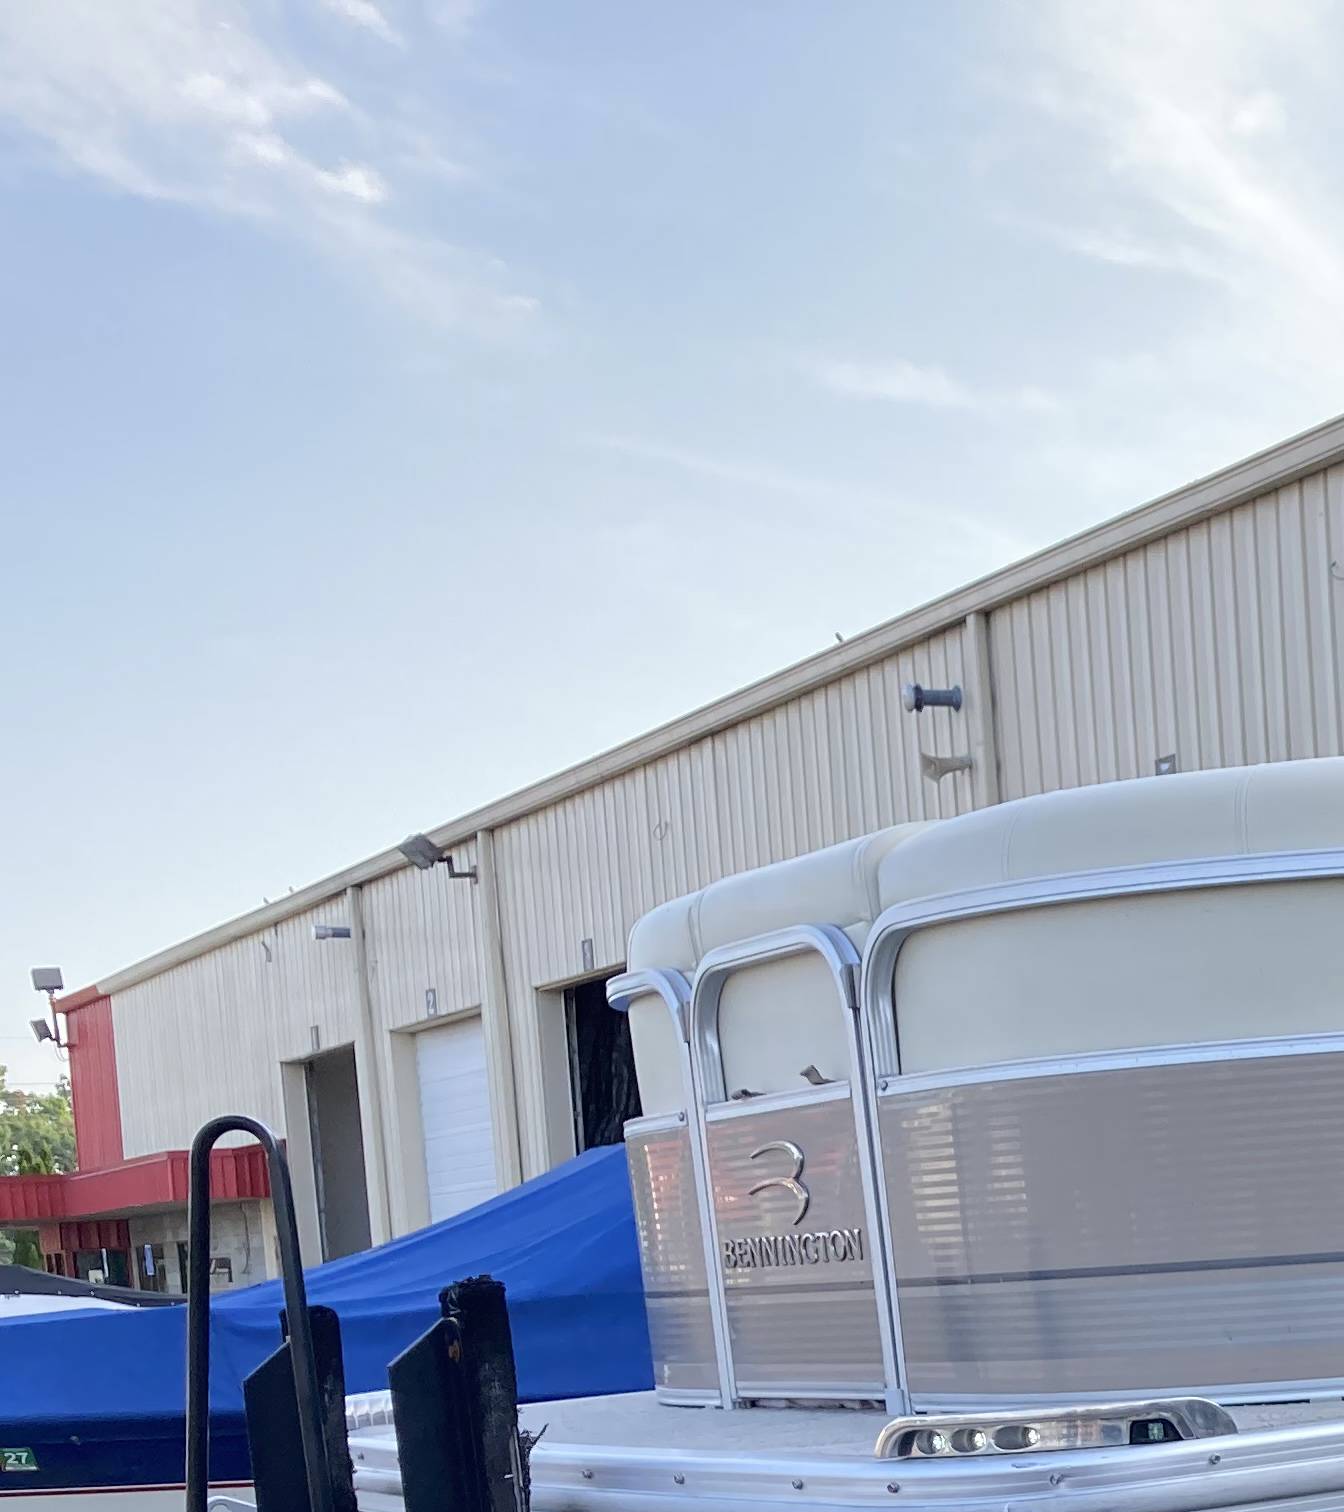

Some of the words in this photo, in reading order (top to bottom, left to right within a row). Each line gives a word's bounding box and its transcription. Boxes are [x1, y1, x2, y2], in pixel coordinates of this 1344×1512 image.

[427, 991, 435, 1015] 2
[723, 1227, 863, 1269] BENNINGTON
[4, 1452, 28, 1464] 27
